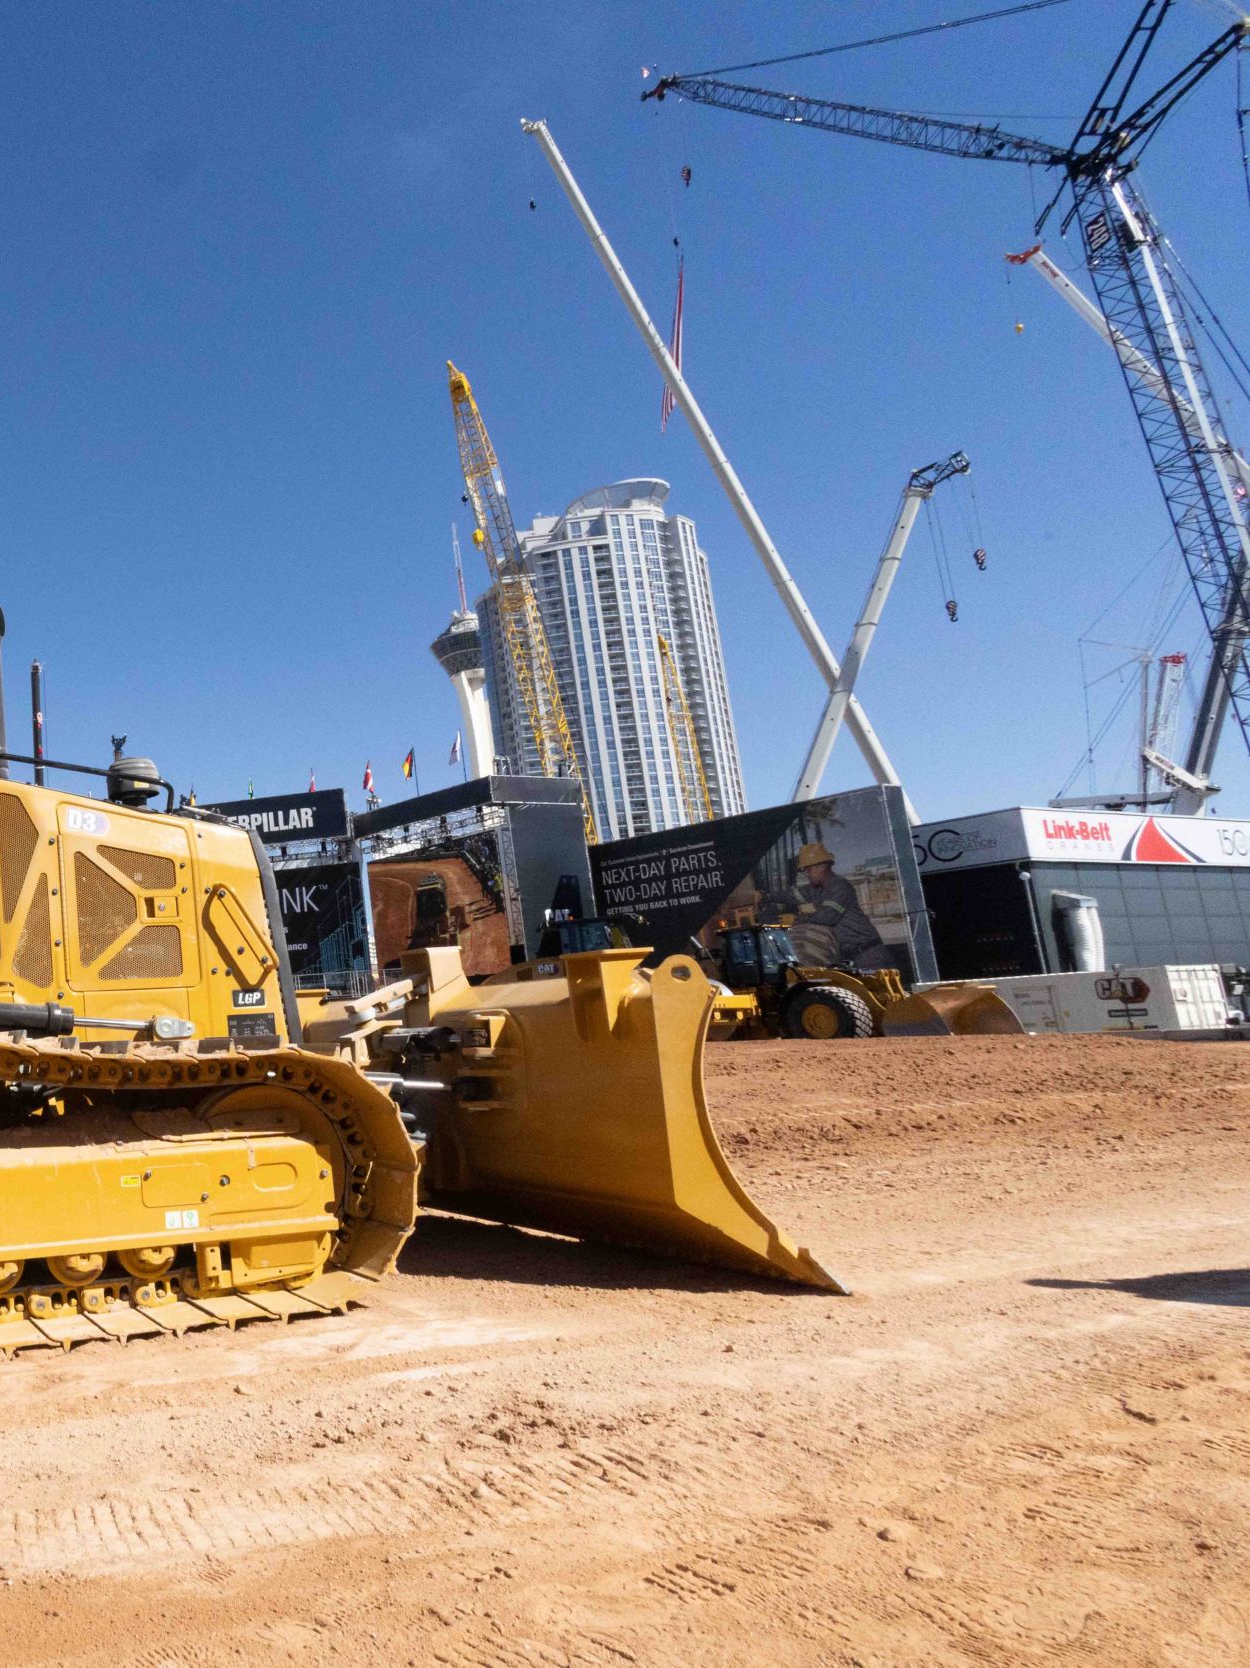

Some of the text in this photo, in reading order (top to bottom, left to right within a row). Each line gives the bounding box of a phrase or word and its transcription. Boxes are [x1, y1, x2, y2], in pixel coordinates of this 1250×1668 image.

[68, 808, 96, 832] D3
[1043, 819, 1111, 842] Link-Belt
[602, 860, 666, 886] NEXT-DAY
[671, 851, 722, 873] PARTS.
[604, 880, 667, 904] TWO-DAY
[607, 904, 634, 915] GETTING
[635, 903, 649, 911] YOU
[650, 900, 668, 909] BACK
[669, 899, 679, 907] TO
[537, 964, 555, 974] CAT
[238, 991, 261, 1004] LGP
[1096, 978, 1135, 1000] CAT
